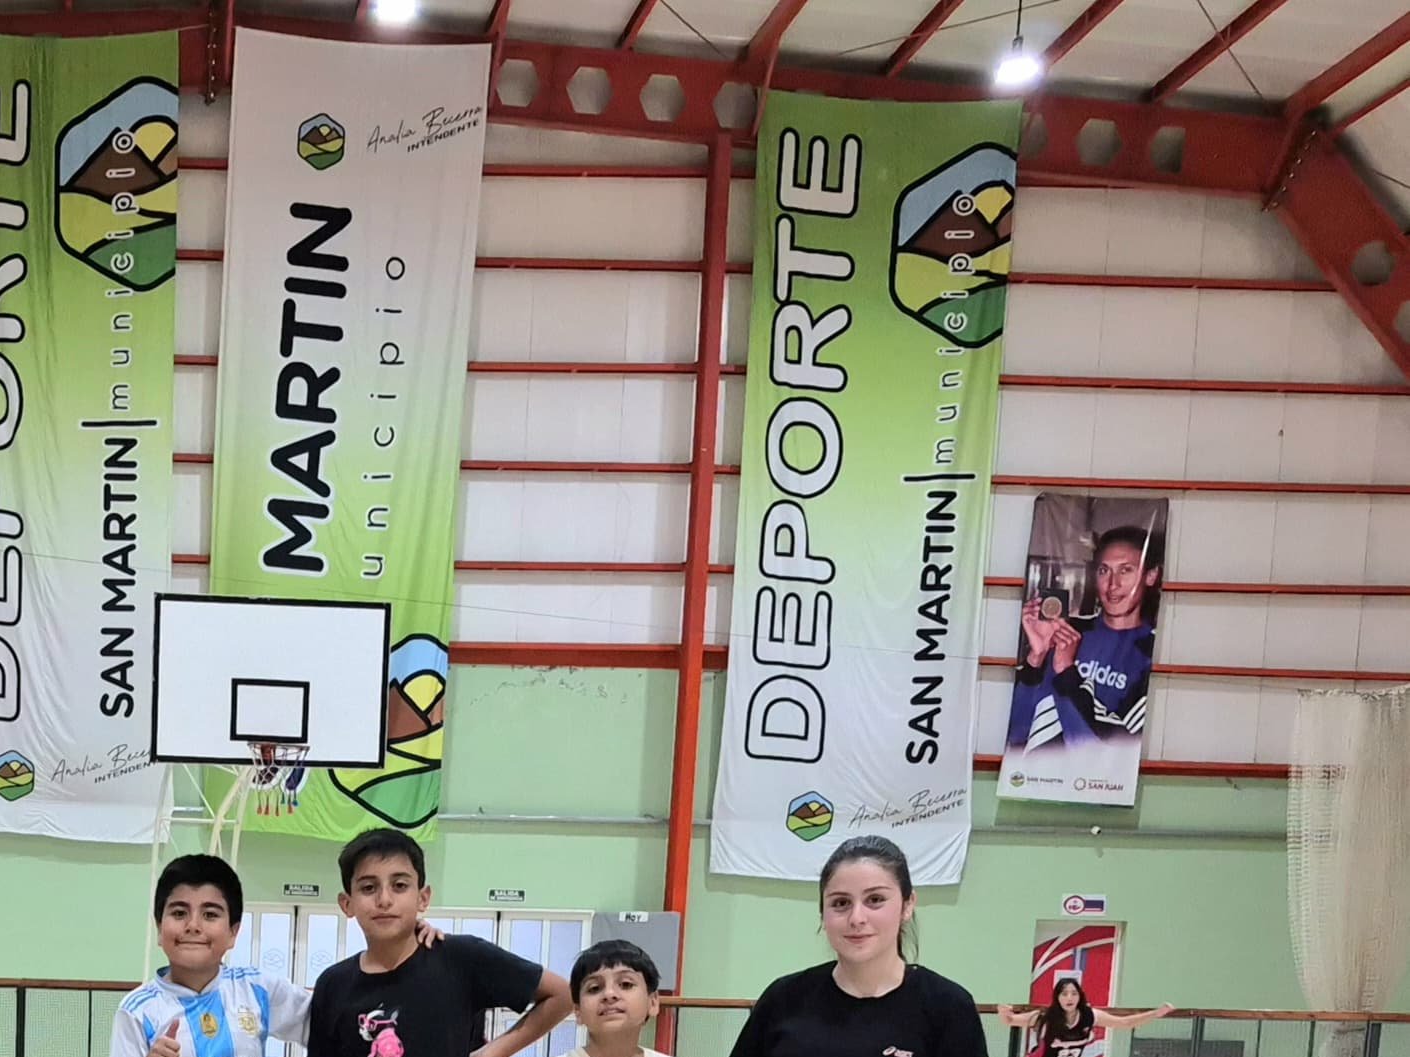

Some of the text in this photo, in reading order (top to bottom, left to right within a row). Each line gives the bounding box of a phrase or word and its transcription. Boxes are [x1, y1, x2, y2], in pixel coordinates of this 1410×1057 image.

[107, 131, 137, 411] municipio
[407, 119, 478, 152] INTENDENTE
[262, 202, 352, 572] MARTIN
[362, 256, 405, 577] unicipio
[745, 128, 862, 763] DEPORTE
[936, 196, 974, 464] municipio
[100, 437, 137, 718] SAN MARTIN
[906, 490, 957, 764] SAN MARTIN
[892, 799, 965, 828] INTENDENTE
